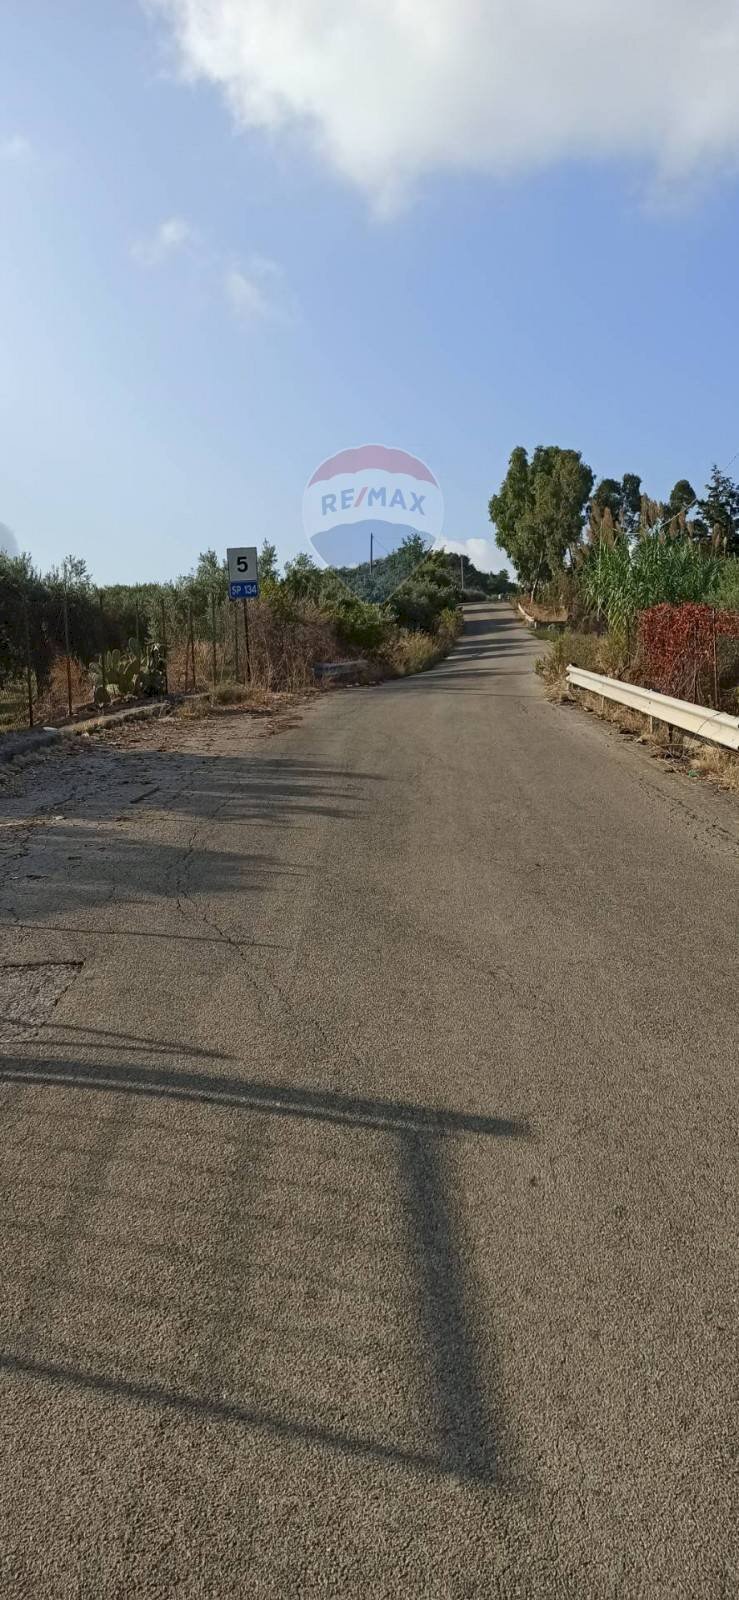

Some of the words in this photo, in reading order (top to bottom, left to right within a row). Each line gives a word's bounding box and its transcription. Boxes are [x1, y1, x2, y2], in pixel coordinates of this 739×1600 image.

[236, 556, 248, 573] 5
[231, 585, 242, 596] SP
[244, 584, 257, 595] 134
